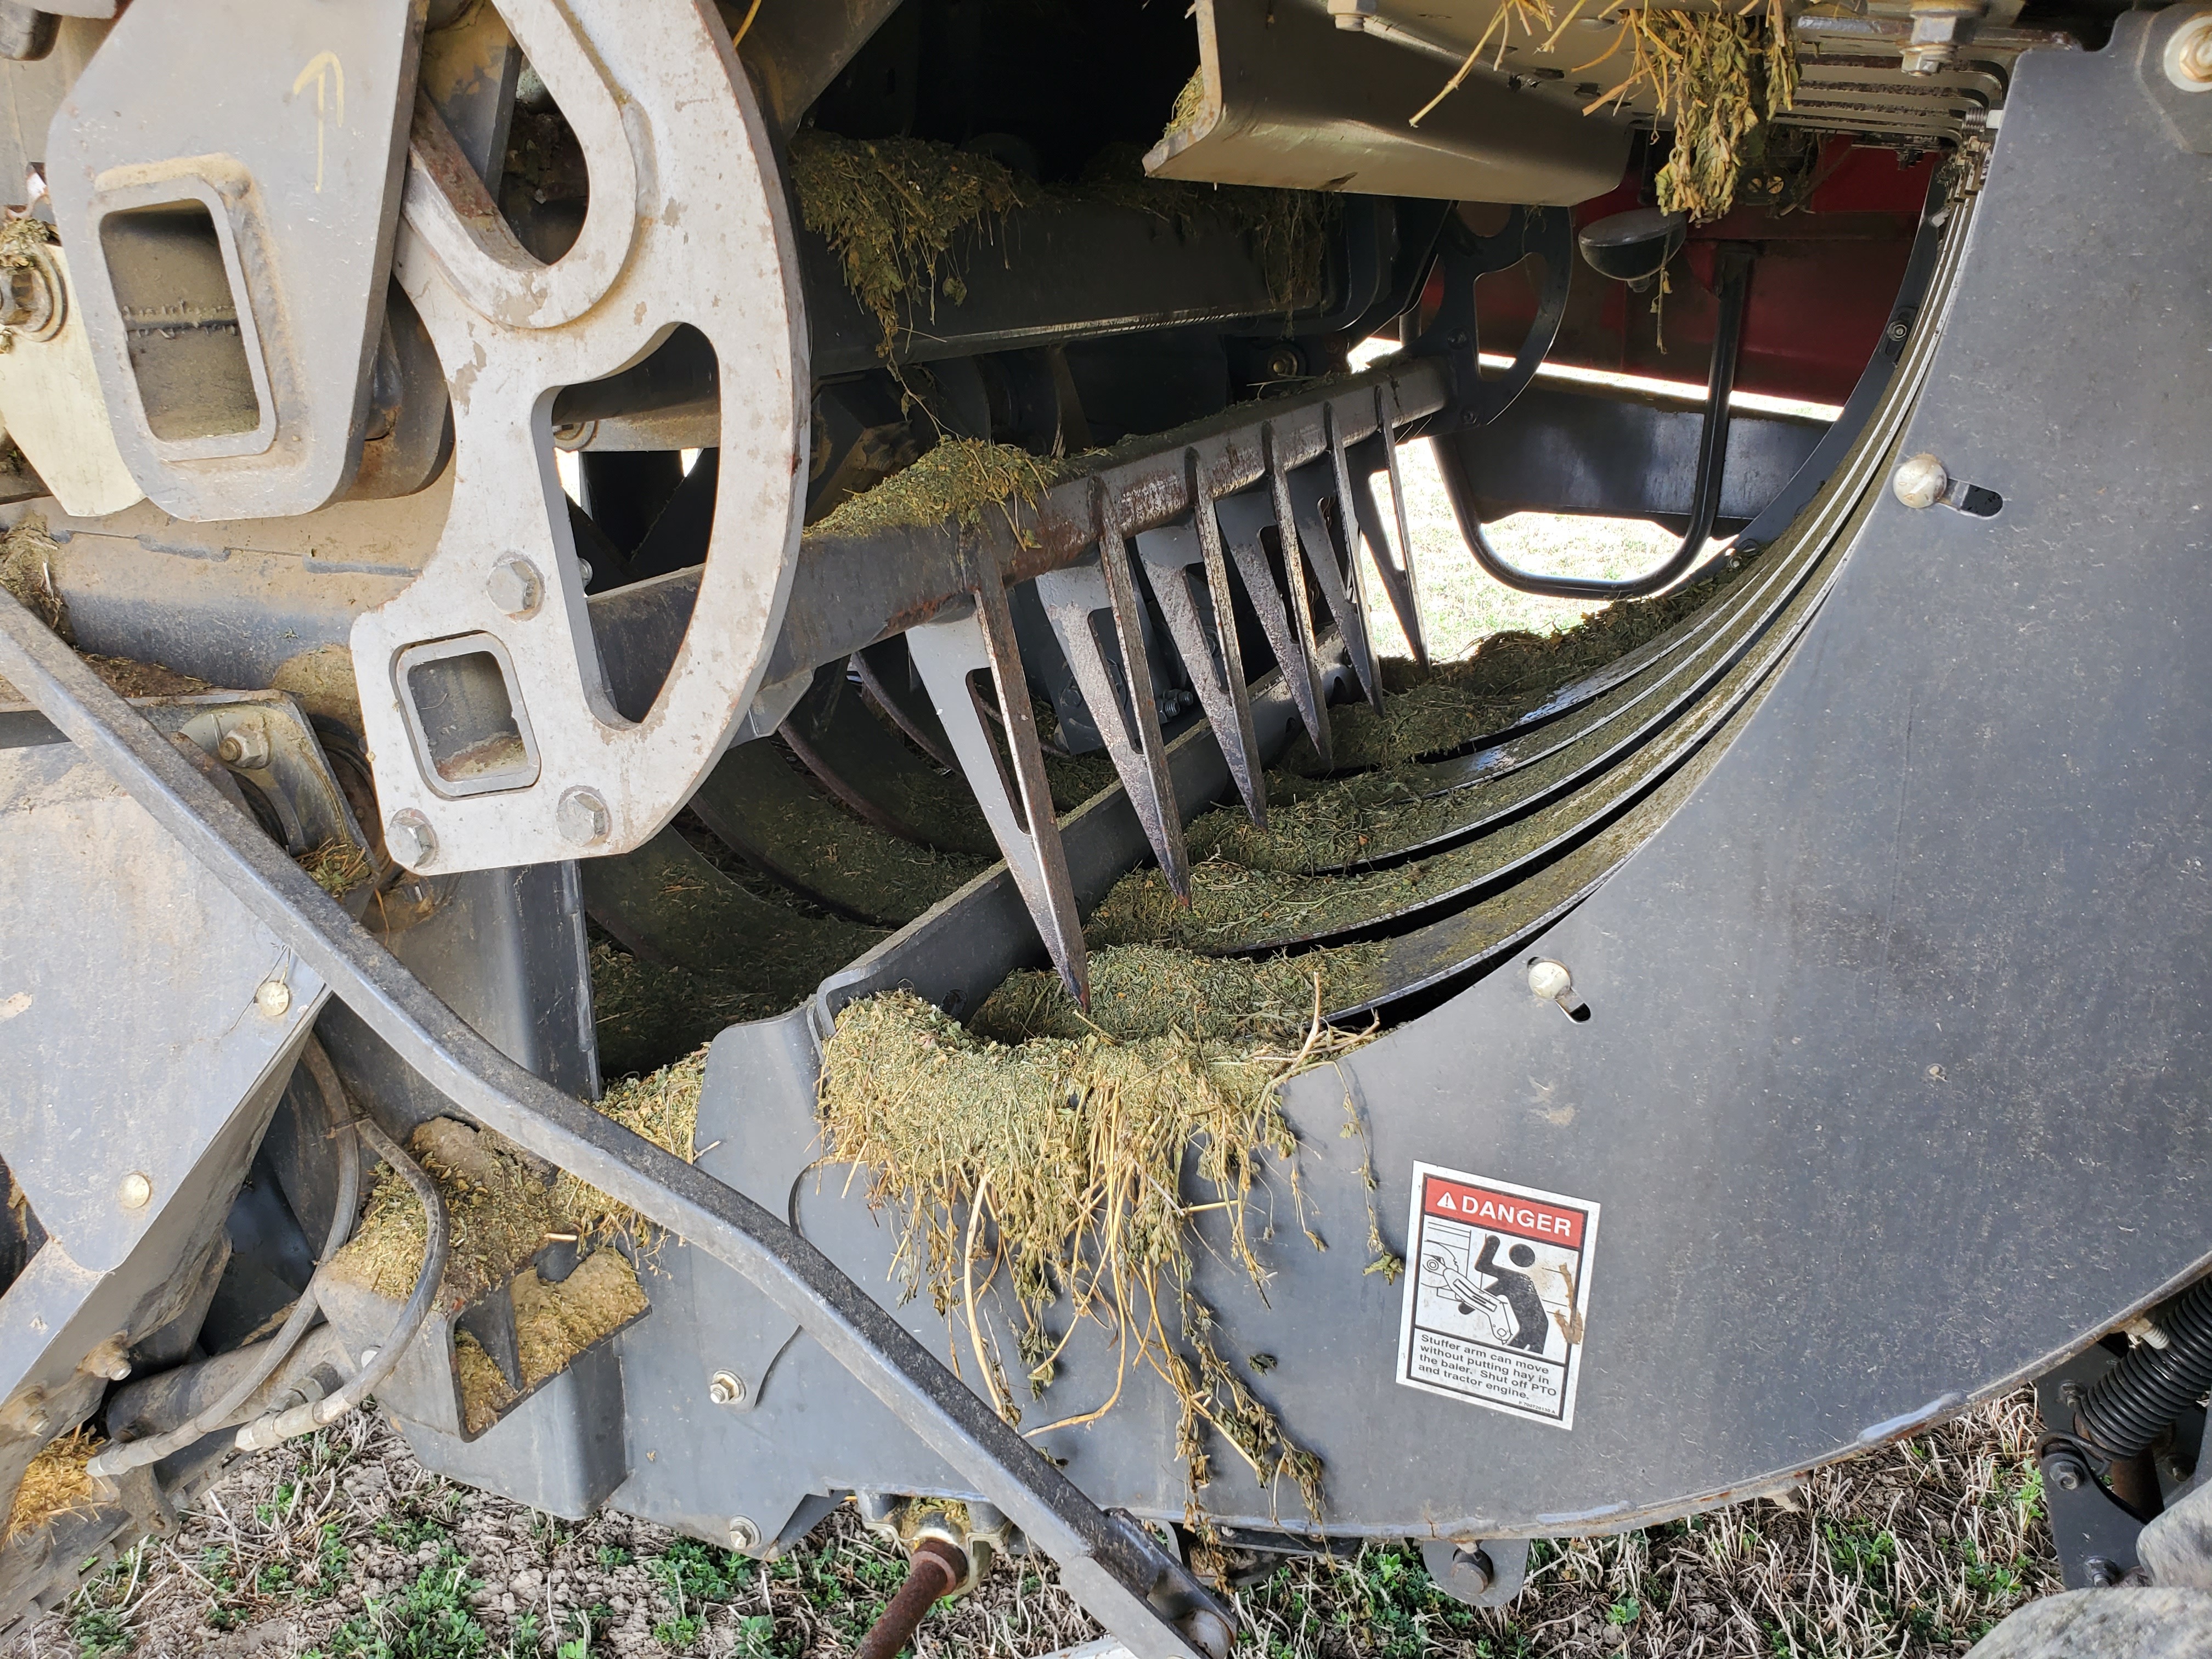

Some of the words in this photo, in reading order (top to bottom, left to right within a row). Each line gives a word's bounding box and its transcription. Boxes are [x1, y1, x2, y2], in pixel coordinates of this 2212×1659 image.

[1462, 1195, 1571, 1237] DANGER
[1420, 1345, 1463, 1362] without
[1468, 1358, 1509, 1375] putting
[1513, 1369, 1534, 1381] hay
[1538, 1375, 1549, 1384] in
[1421, 1334, 1460, 1350] Stuffer
[1464, 1347, 1486, 1358] arm
[1491, 1354, 1511, 1364] can
[1516, 1361, 1549, 1374] move
[1419, 1364, 1440, 1375] and
[1444, 1370, 1482, 1386] tractor
[1486, 1383, 1530, 1400] engine.
[1420, 1354, 1437, 1364] the
[1441, 1359, 1472, 1374] baler.
[1480, 1370, 1508, 1383] Shut
[1511, 1380, 1527, 1389] off
[1531, 1383, 1556, 1396] PTO
